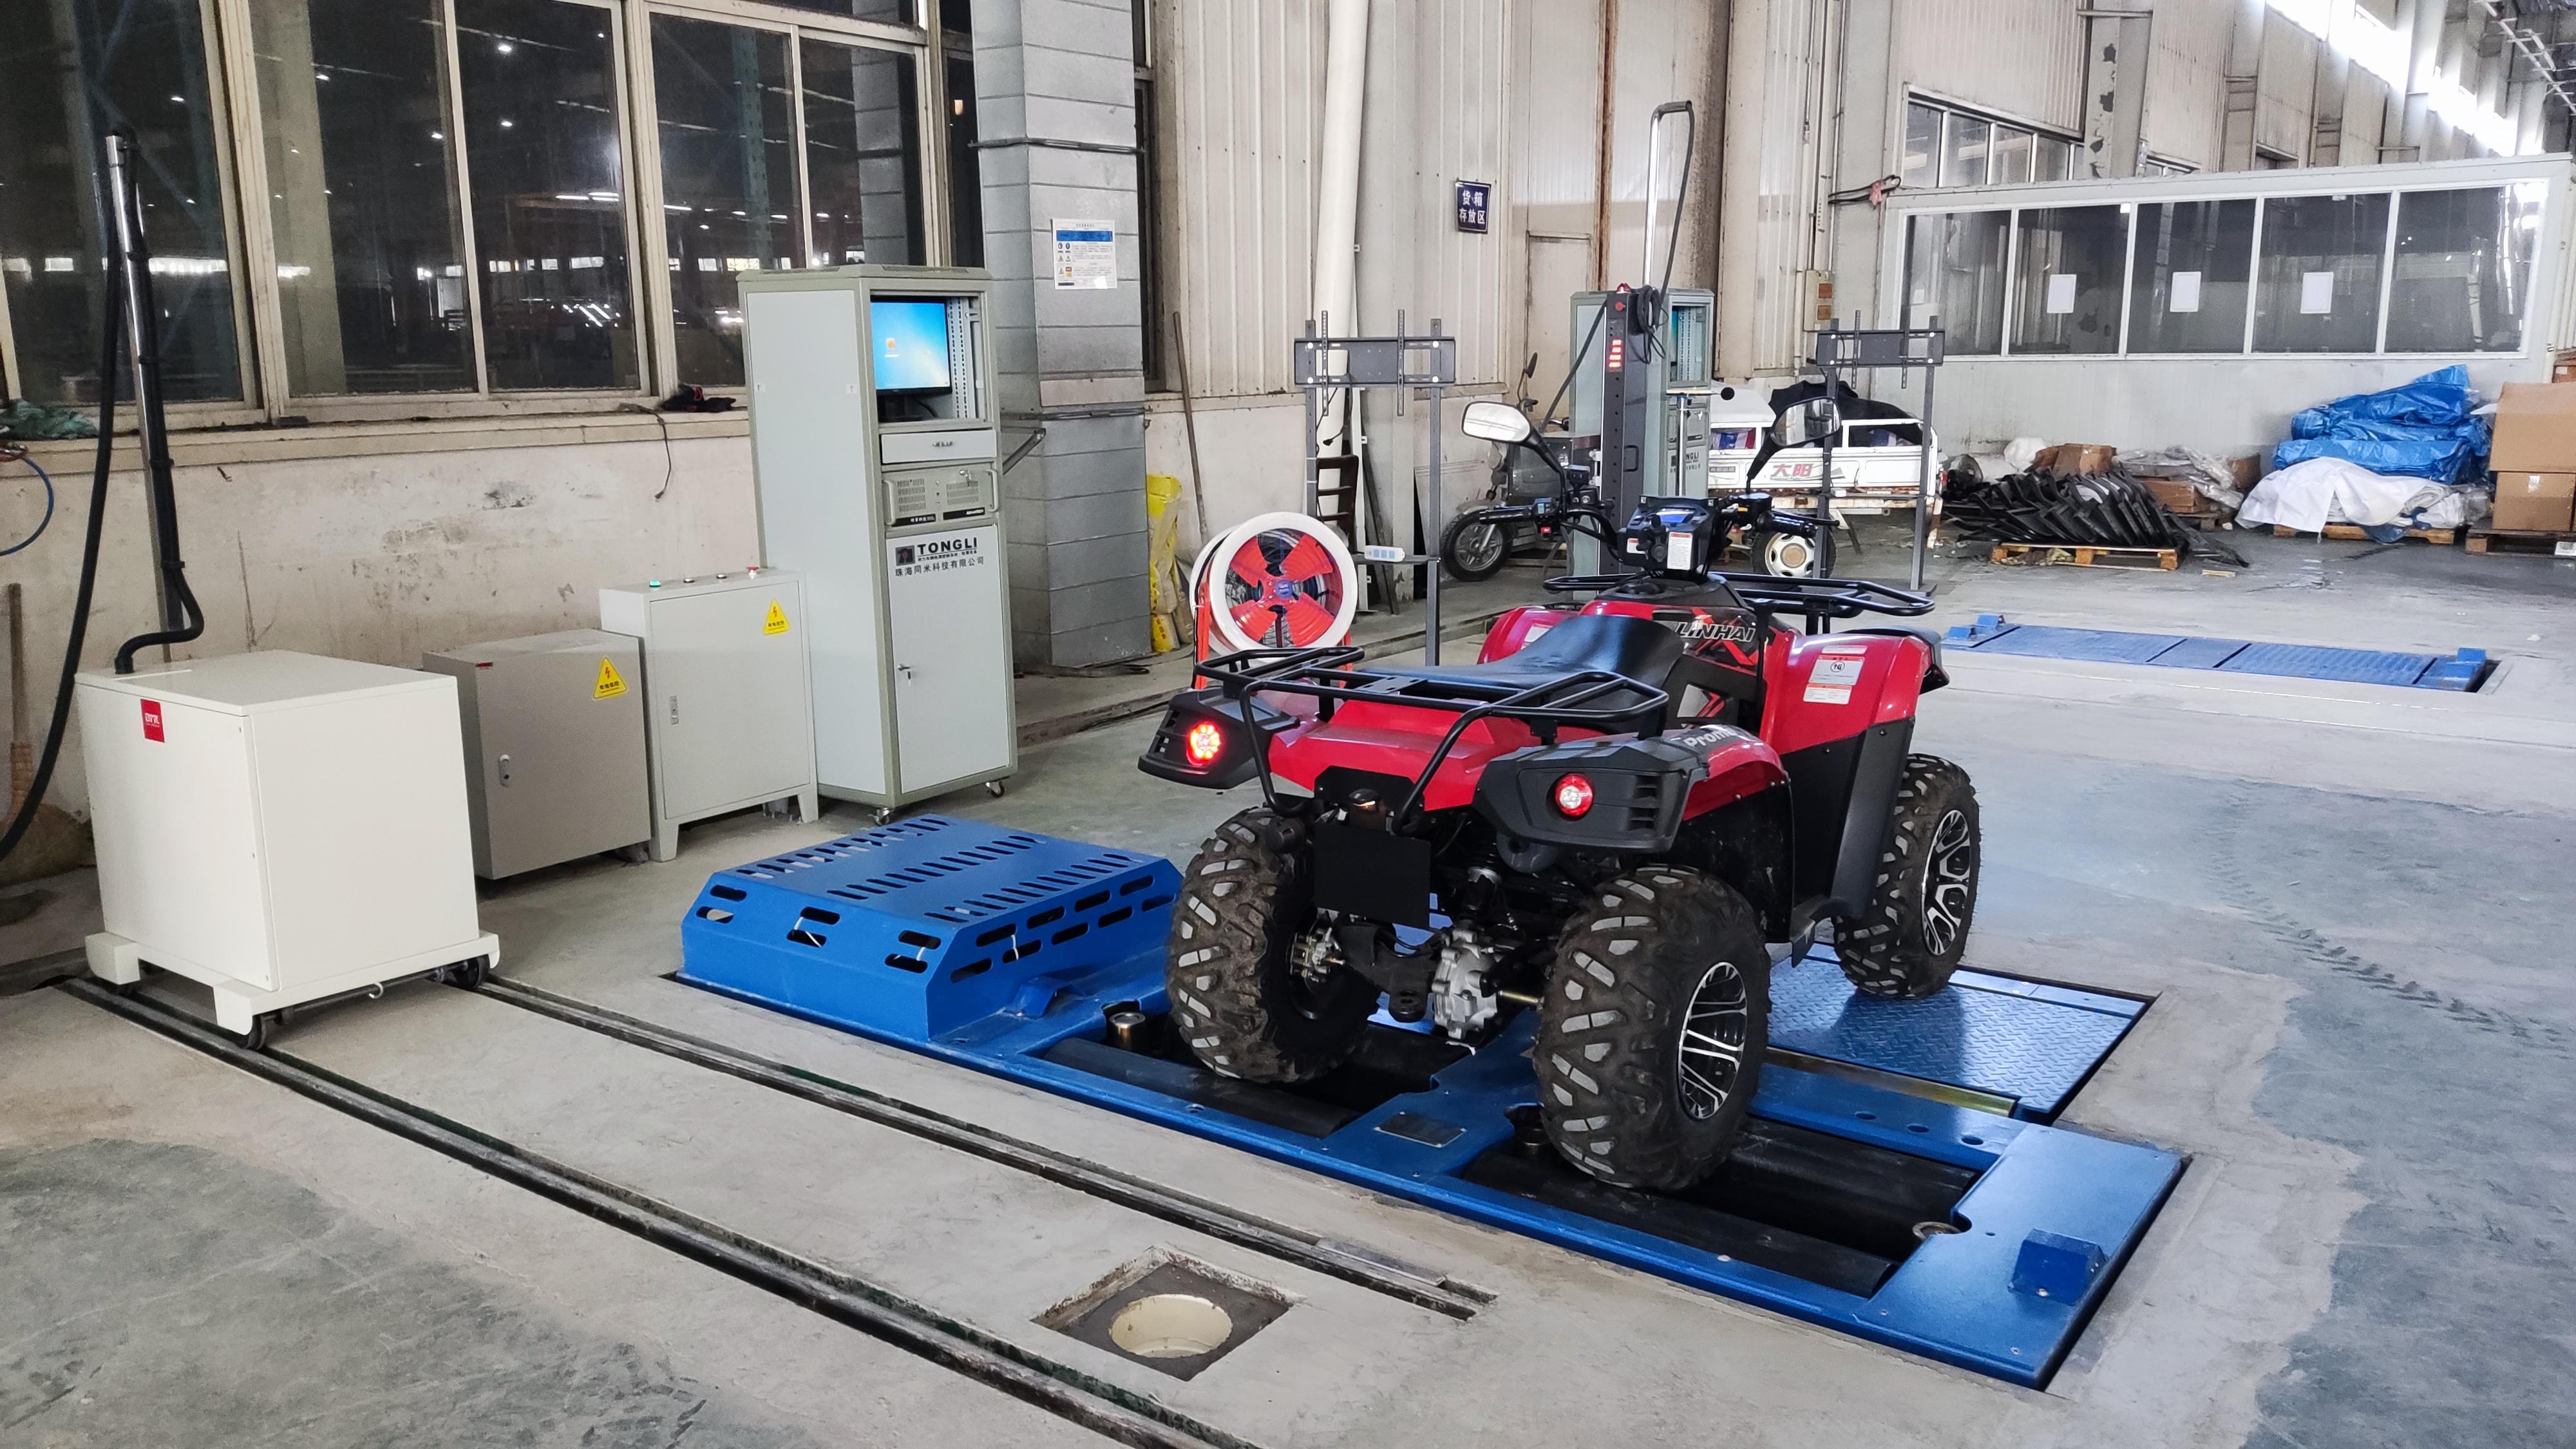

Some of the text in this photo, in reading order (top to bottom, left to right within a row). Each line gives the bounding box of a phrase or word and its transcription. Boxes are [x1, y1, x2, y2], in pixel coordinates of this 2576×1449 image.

[1462, 189, 1483, 207] 货箱
[1459, 207, 1485, 224] 存放区
[1772, 463, 1814, 477] 大阳
[917, 537, 977, 554] TONGLI
[1674, 621, 1756, 643] LINHAI
